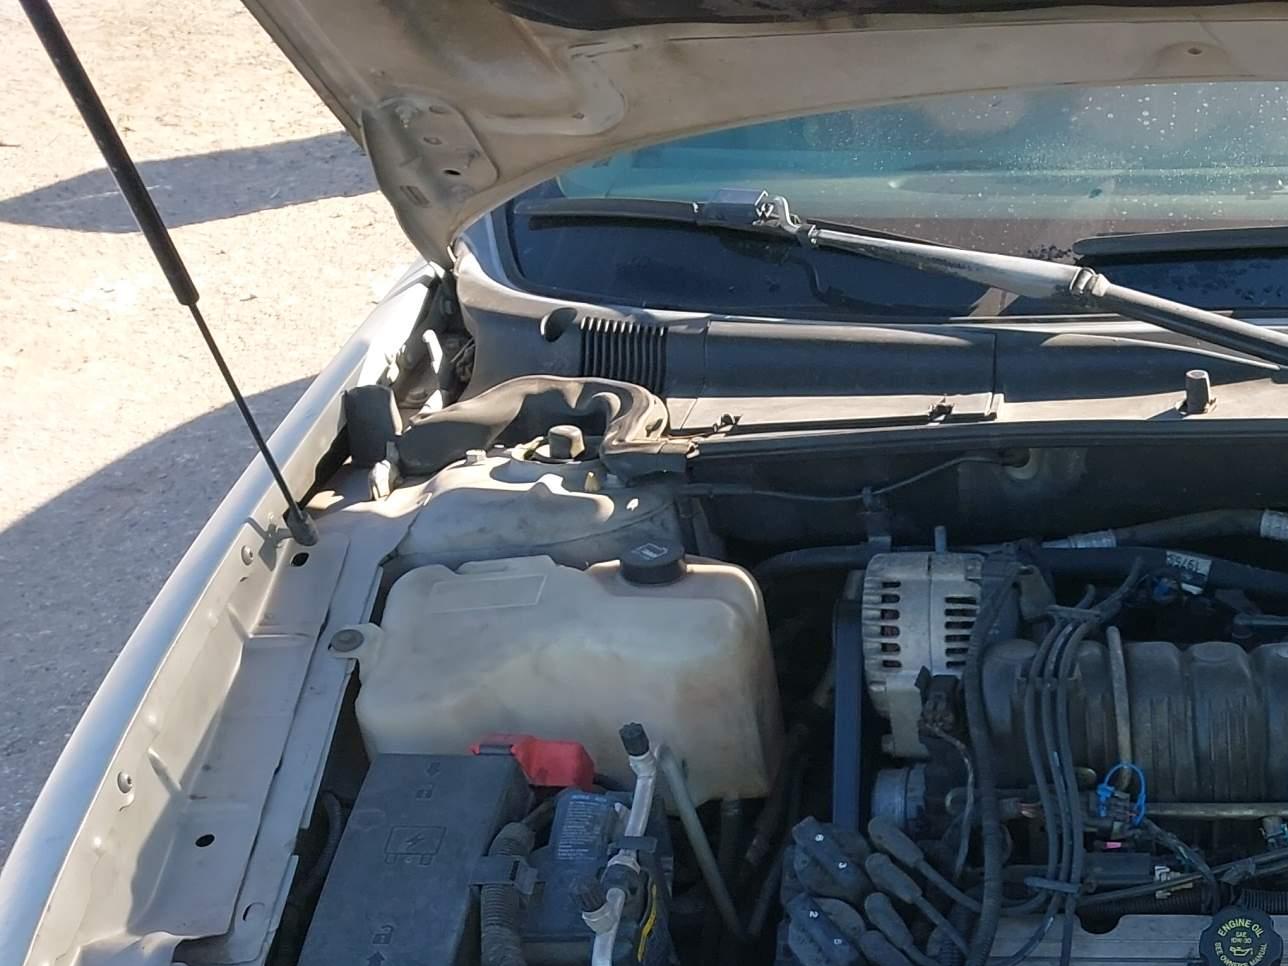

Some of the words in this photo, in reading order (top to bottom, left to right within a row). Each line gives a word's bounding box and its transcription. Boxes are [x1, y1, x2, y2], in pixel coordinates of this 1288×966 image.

[1218, 918, 1252, 937] ENGINE
[1251, 923, 1264, 938] OIL
[1249, 943, 1267, 966] MANUAL
